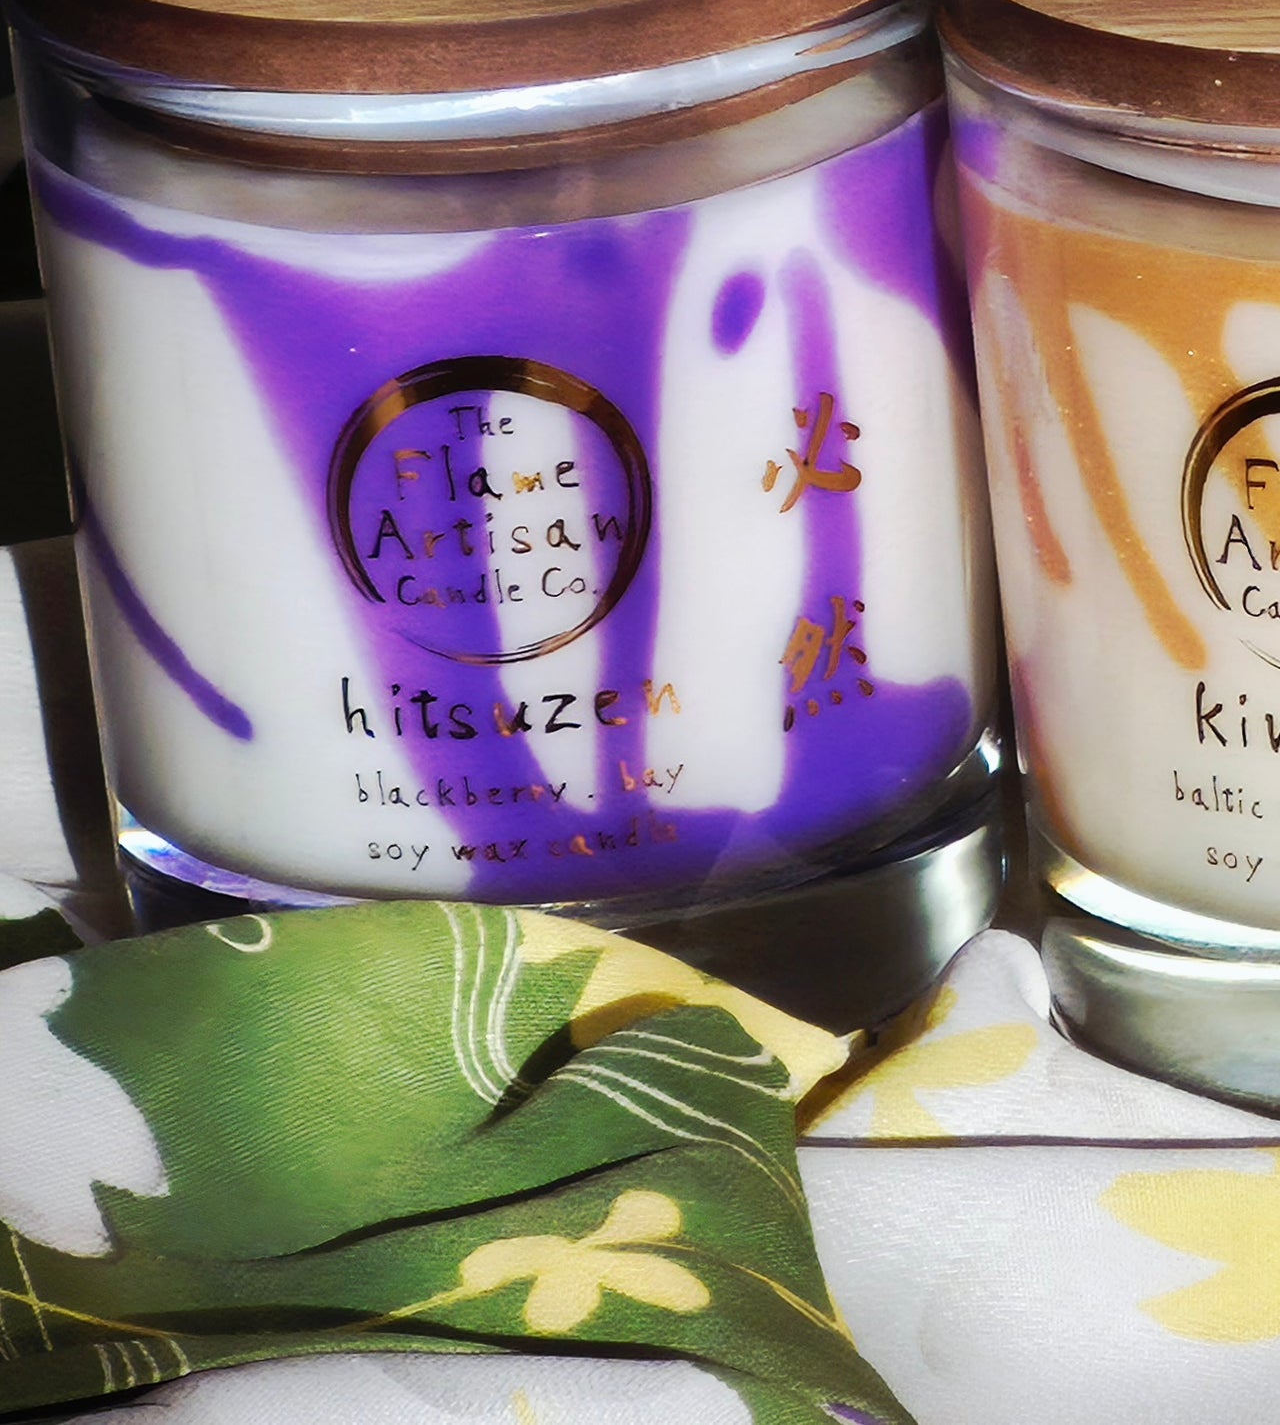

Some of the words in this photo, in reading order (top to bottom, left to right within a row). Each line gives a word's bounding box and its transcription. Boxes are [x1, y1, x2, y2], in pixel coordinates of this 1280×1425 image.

[448, 404, 515, 441] The
[392, 443, 581, 502] Flame
[367, 509, 624, 561] Artisan
[760, 390, 876, 733] 必然
[396, 569, 524, 608] Candle
[540, 567, 598, 598] Co.
[340, 676, 683, 741] hitsuzen
[356, 773, 568, 809] blackberry
[619, 760, 685, 795] bay
[1172, 770, 1265, 822] baltic
[367, 839, 429, 872] soy
[450, 838, 529, 863] wax
[1206, 844, 1264, 884] soy
